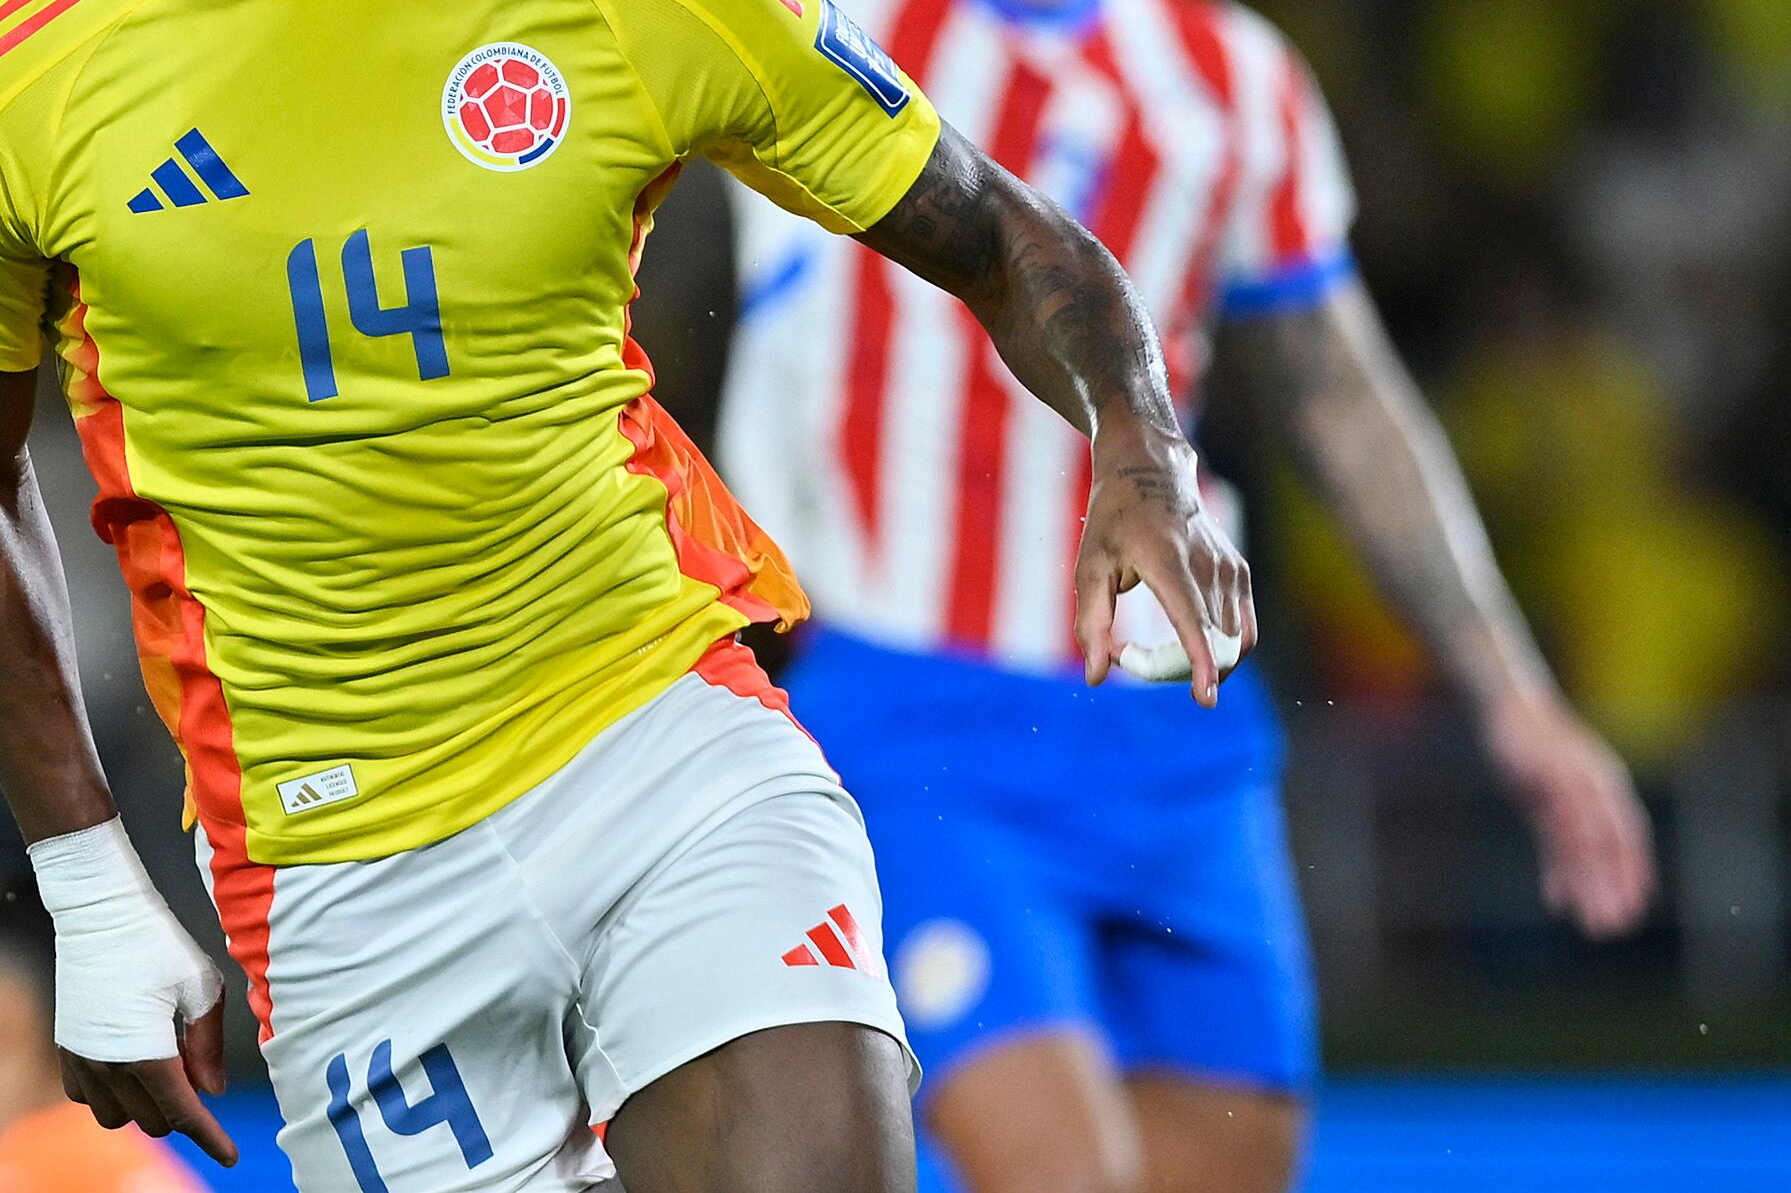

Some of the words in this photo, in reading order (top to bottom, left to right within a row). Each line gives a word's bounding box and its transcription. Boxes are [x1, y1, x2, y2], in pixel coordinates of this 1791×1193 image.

[472, 46, 529, 65] COLOMBIANA
[529, 54, 542, 66] DE
[540, 62, 564, 95] FUTBOL
[287, 227, 451, 403] 14
[325, 1037, 495, 1193] 14
